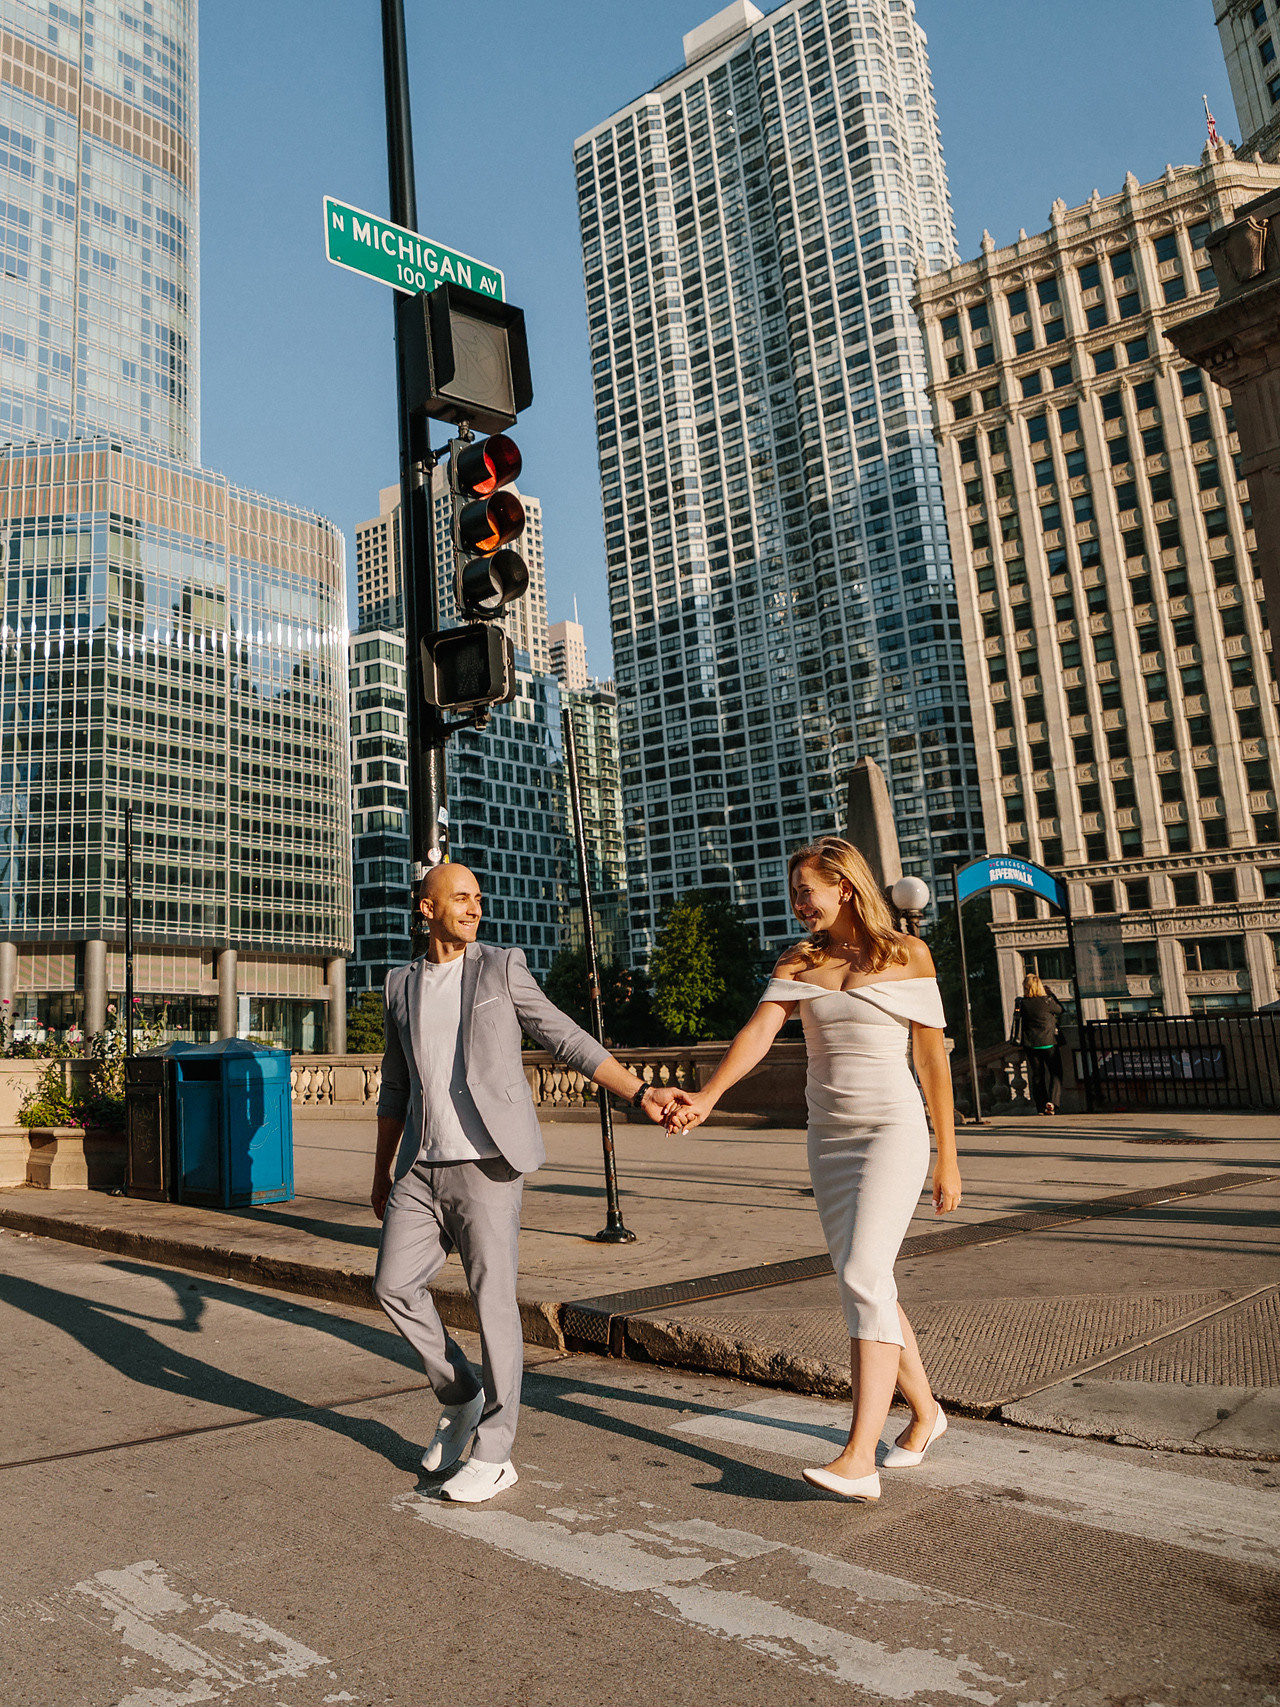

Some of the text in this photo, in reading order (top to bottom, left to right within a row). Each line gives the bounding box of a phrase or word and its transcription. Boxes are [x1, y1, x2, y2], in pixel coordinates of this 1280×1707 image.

[332, 212, 344, 232] N
[352, 216, 472, 289] MICHIGAN
[479, 275, 498, 295] AV
[397, 263, 426, 290] 100
[995, 861, 1025, 870] CHICAGO
[989, 868, 1034, 886] RIVERWALK
